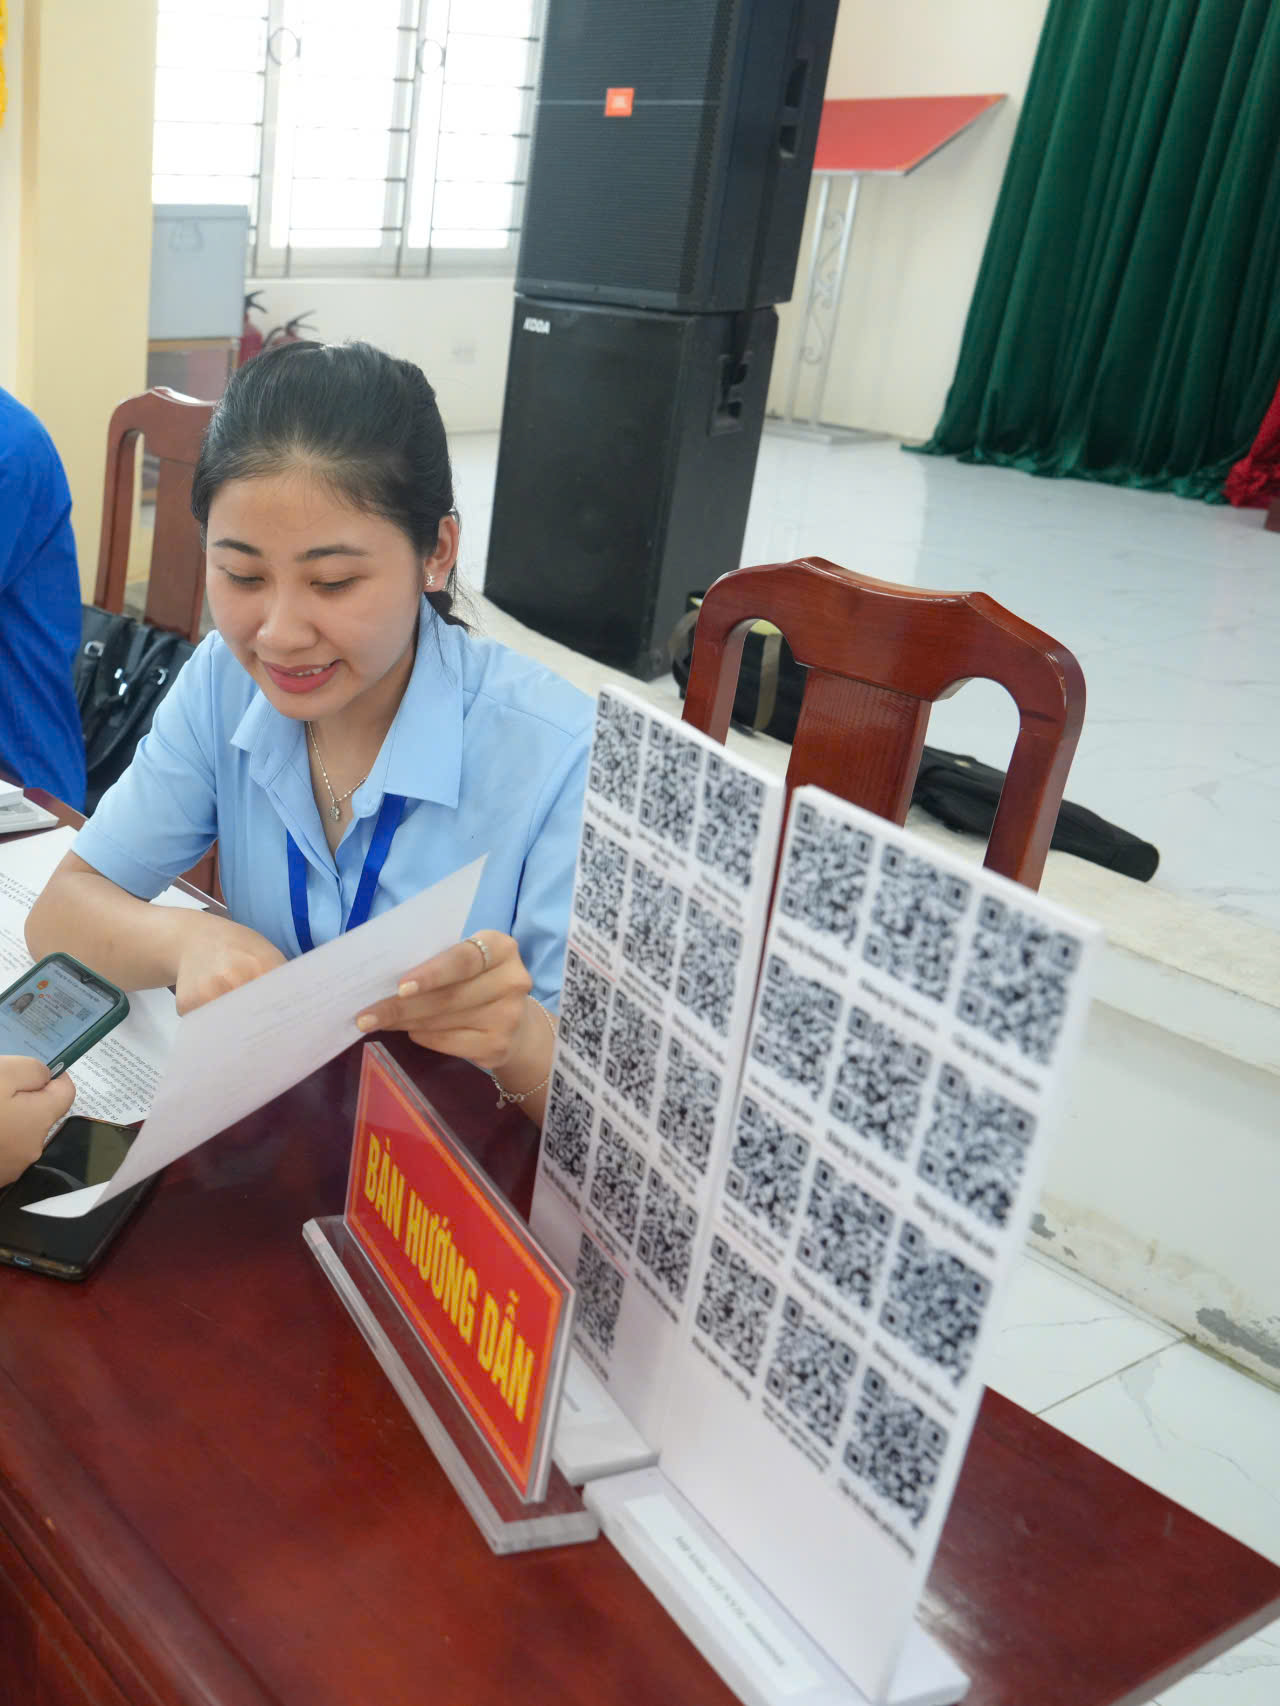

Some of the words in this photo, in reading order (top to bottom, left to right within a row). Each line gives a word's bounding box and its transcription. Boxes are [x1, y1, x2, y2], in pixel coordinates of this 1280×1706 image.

[364, 1132, 405, 1241] BÀN
[404, 1188, 478, 1346] HƯỚNG
[477, 1288, 534, 1425] DẪN
